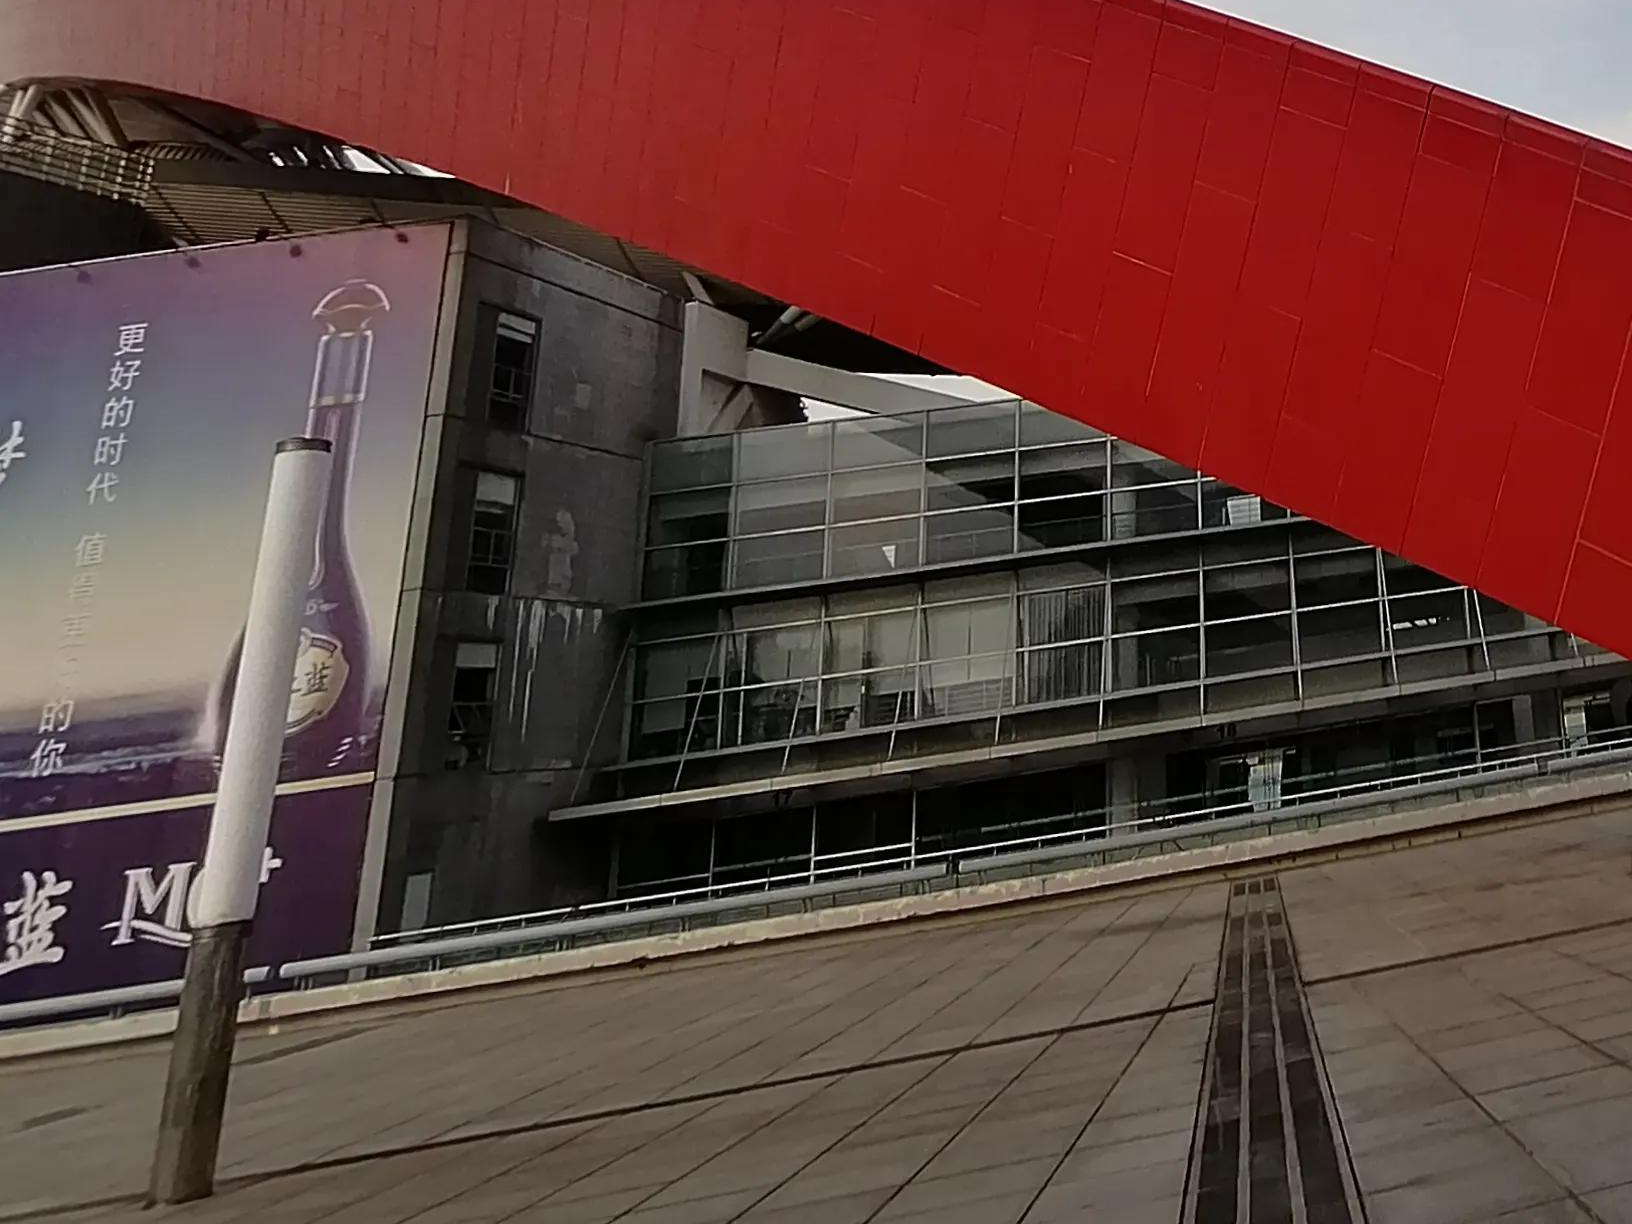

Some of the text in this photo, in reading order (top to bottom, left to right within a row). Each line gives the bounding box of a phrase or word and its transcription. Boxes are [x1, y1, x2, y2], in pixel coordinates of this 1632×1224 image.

[86, 322, 149, 505] 更好的时代
[290, 660, 331, 697] 蓝
[0, 846, 283, 975] 蓝 M+
